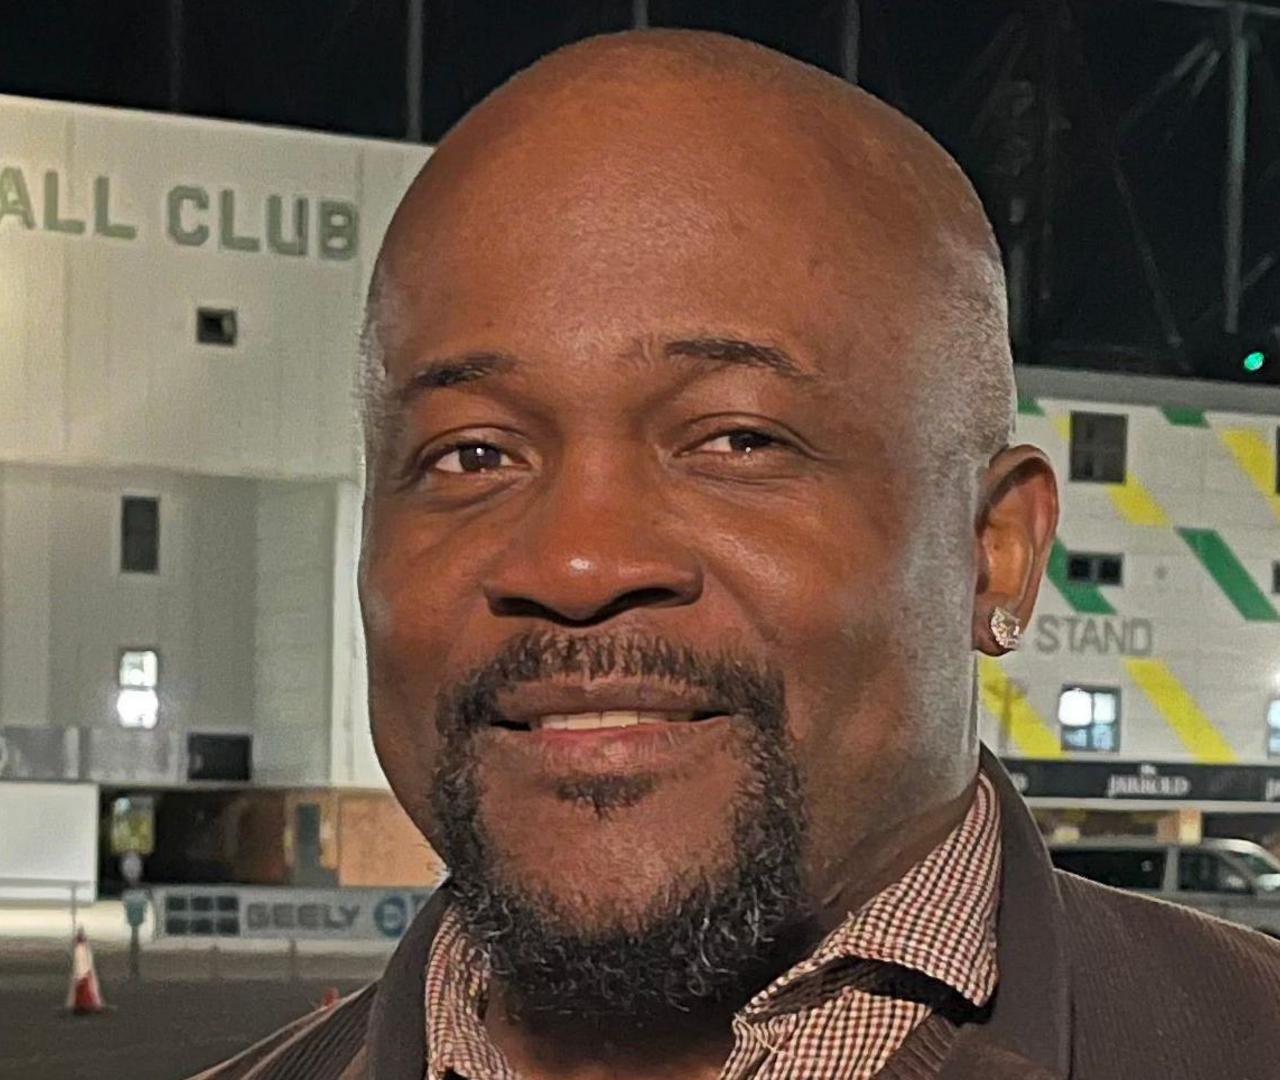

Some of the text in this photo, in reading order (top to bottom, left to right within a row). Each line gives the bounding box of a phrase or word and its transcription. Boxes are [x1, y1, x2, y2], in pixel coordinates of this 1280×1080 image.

[166, 184, 360, 261] CLUB
[1035, 614, 1153, 656] STAND
[246, 902, 361, 931] GEELY
